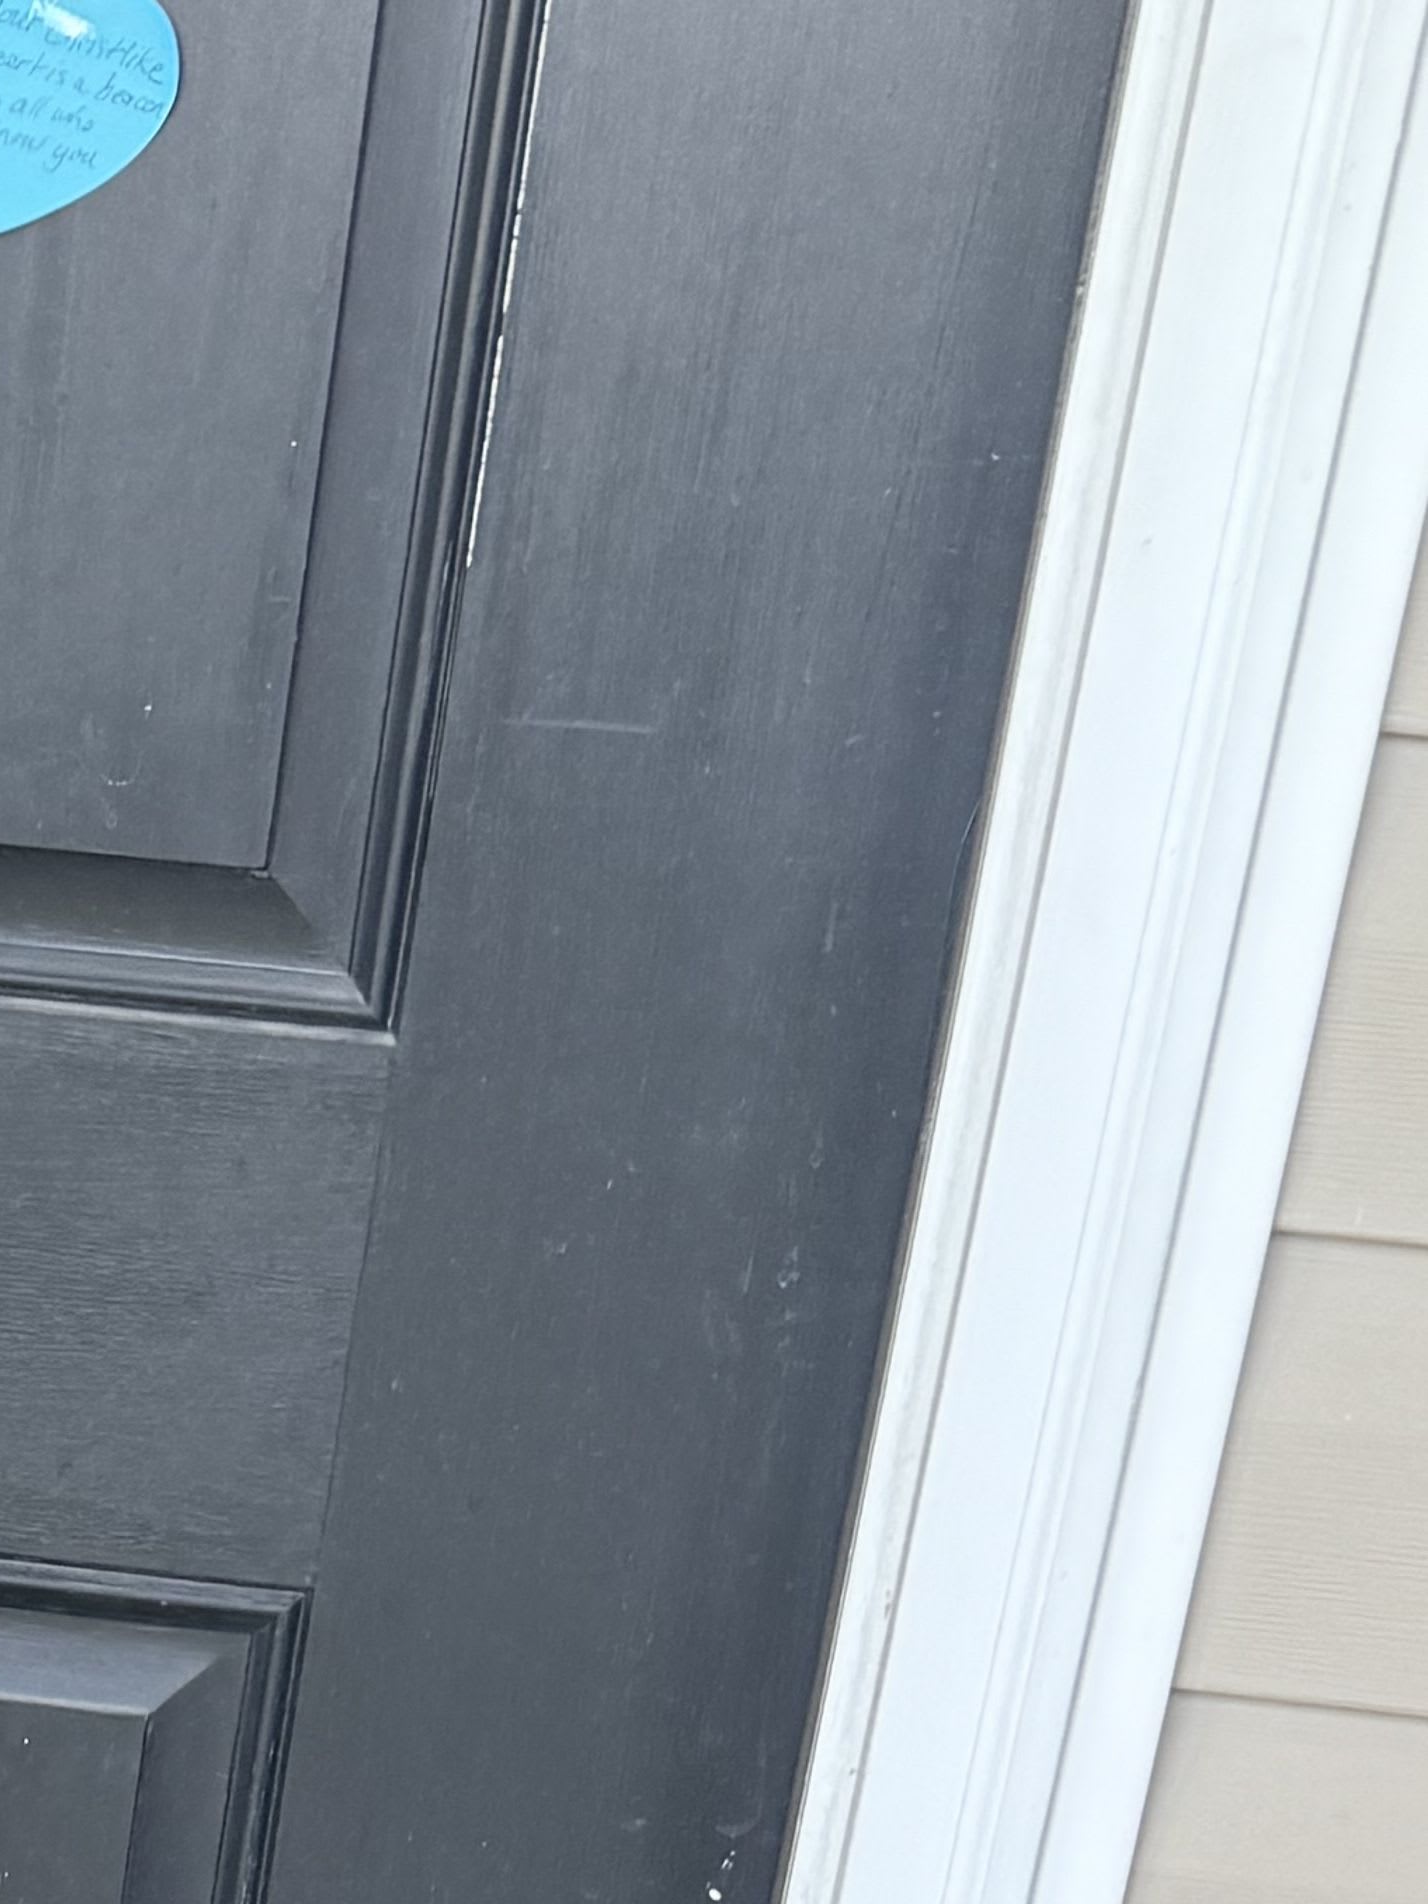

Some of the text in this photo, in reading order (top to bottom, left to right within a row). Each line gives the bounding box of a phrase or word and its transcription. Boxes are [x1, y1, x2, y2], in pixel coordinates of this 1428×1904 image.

[46, 67, 68, 86] is
[73, 77, 89, 95] a
[9, 96, 51, 121] all
[50, 105, 96, 133] who
